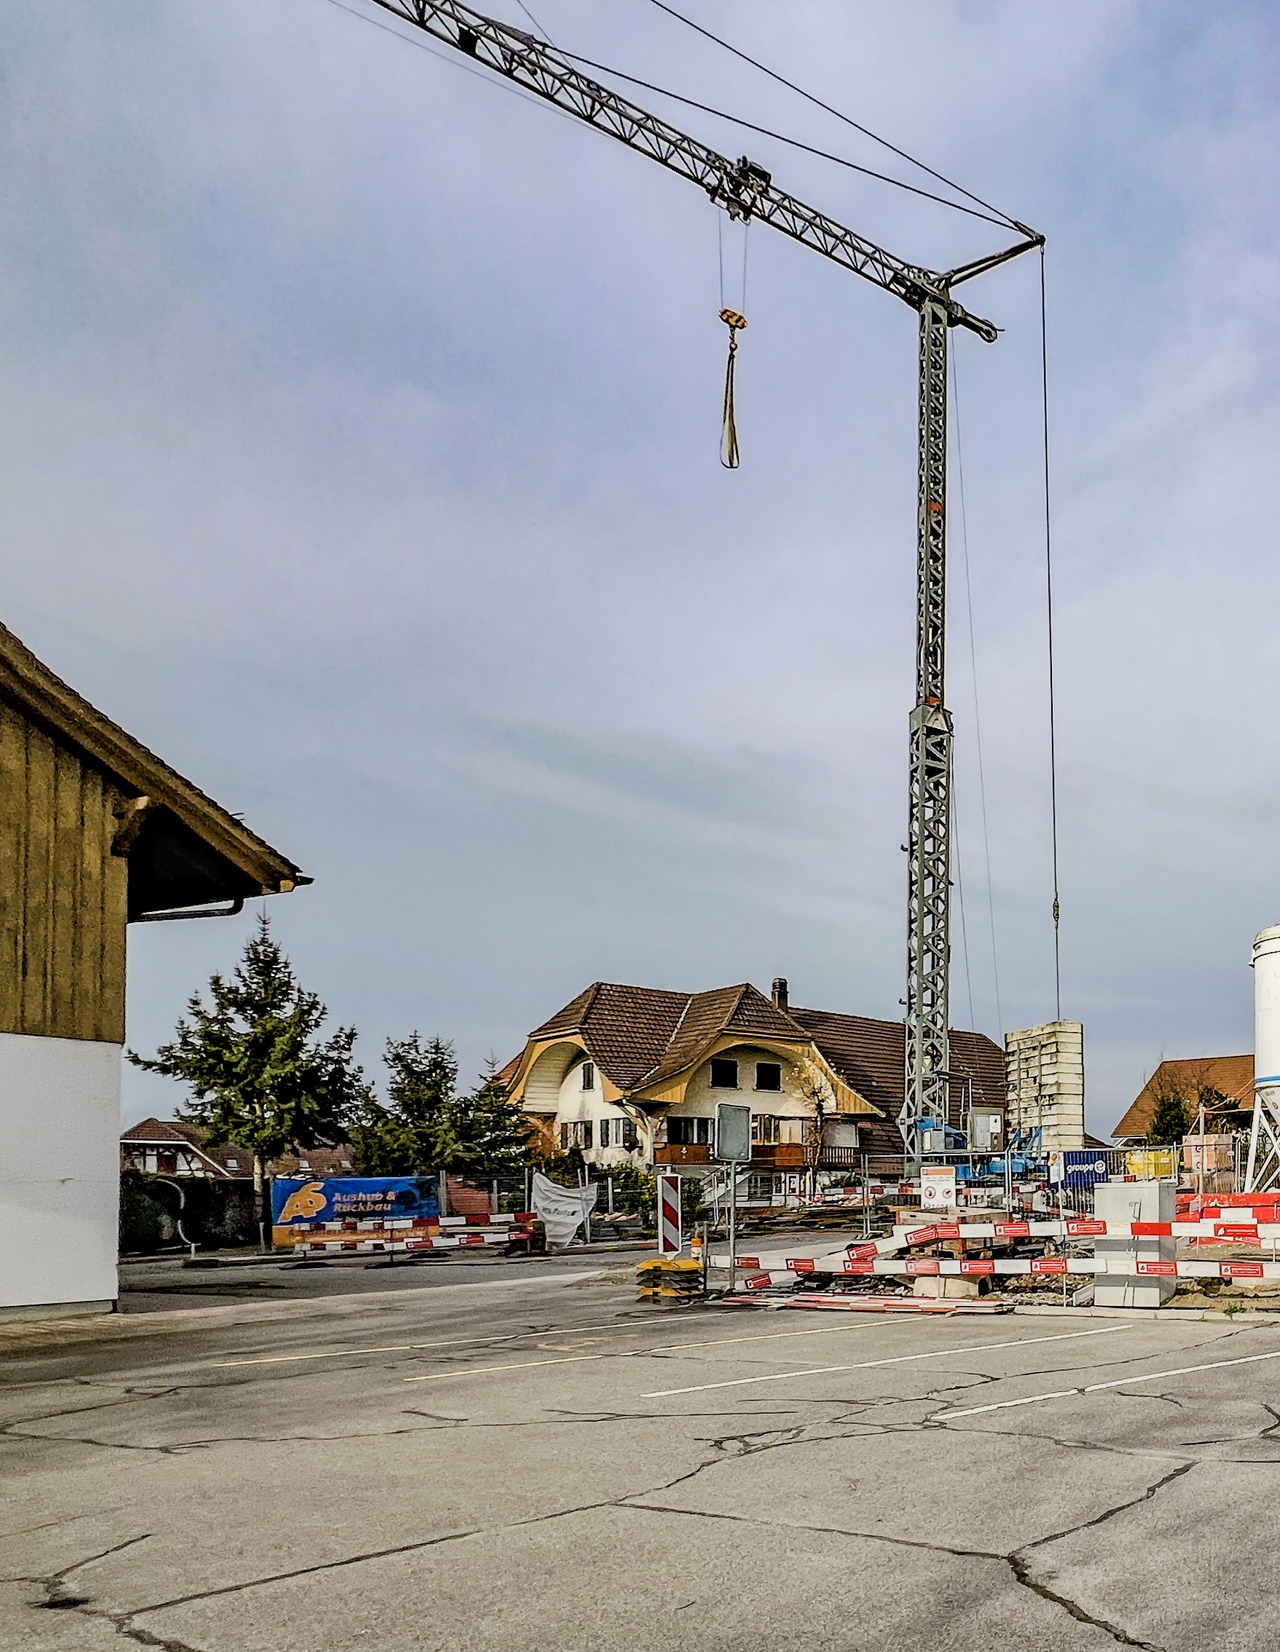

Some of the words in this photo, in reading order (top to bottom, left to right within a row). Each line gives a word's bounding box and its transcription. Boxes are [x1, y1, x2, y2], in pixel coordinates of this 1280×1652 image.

[1066, 1164, 1094, 1174] groupe
[332, 1192, 384, 1202] Aushub
[386, 1191, 396, 1200] &
